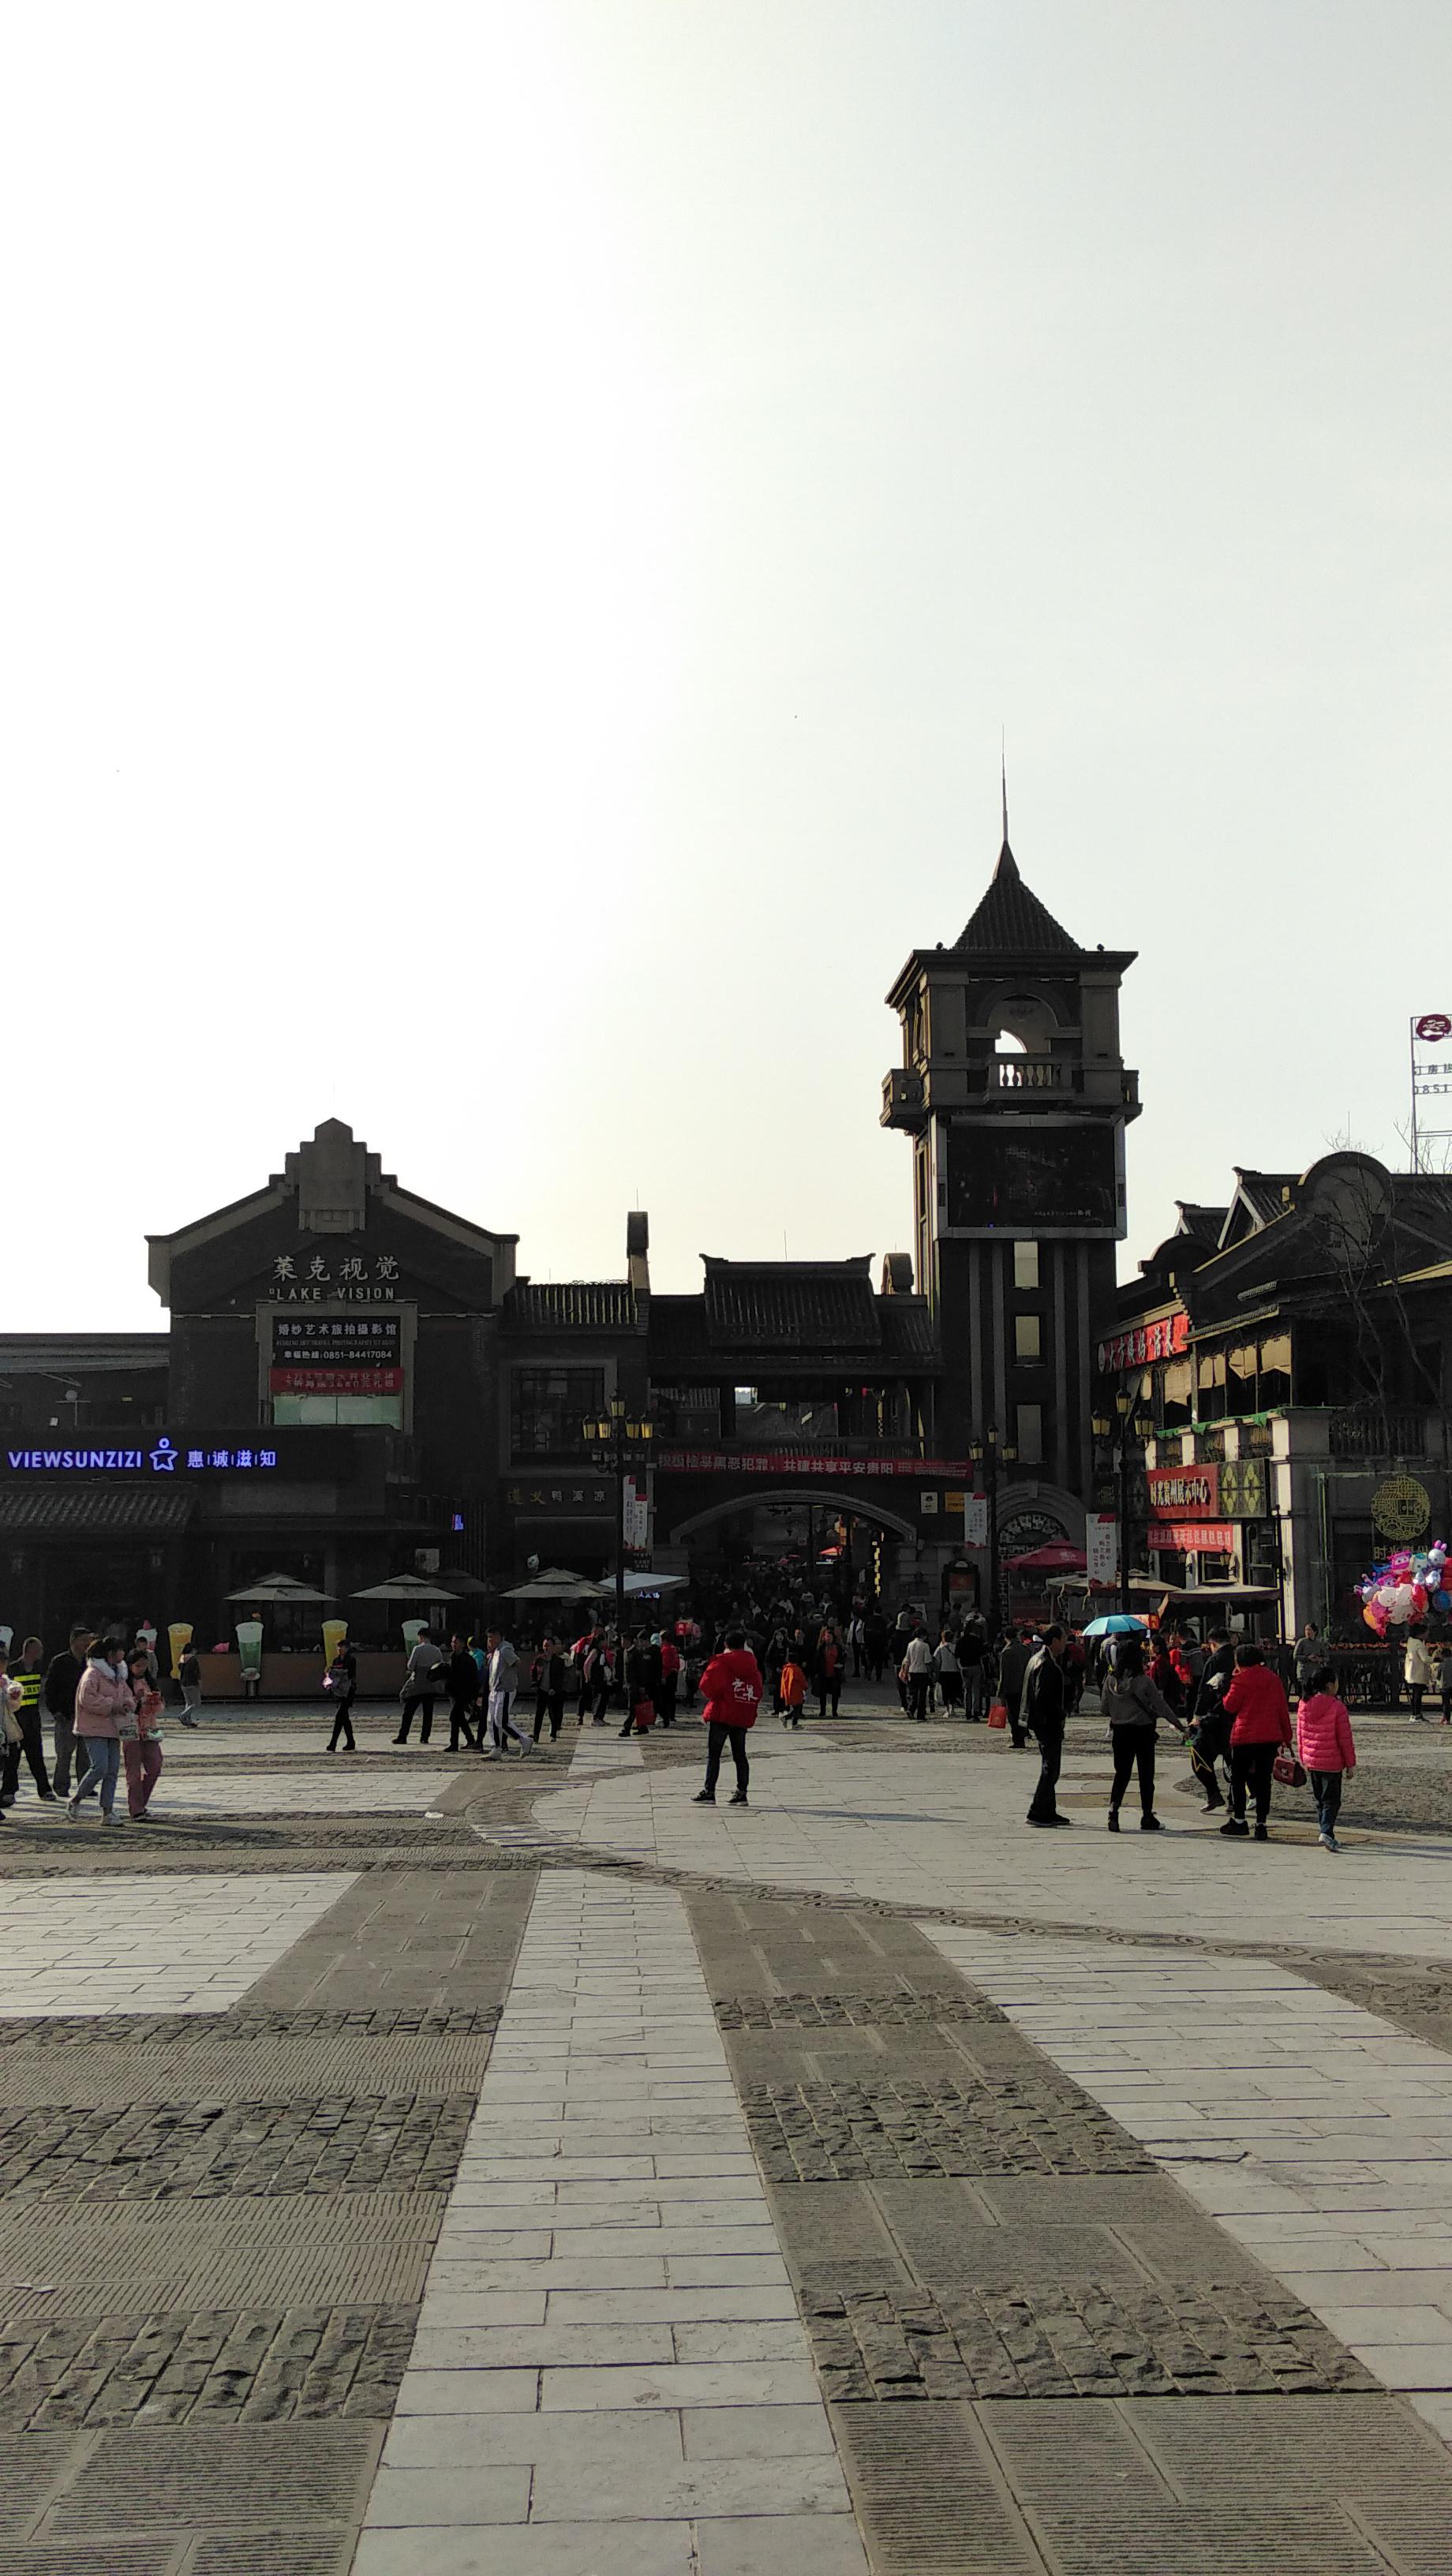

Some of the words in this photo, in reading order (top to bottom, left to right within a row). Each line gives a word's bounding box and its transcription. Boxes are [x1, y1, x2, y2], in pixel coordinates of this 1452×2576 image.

[271, 1255, 400, 1282] 莱克视觉
[277, 1287, 322, 1300] LAKE
[337, 1287, 395, 1300] VISION
[8, 1451, 142, 1469] VIEWSUNZIZI
